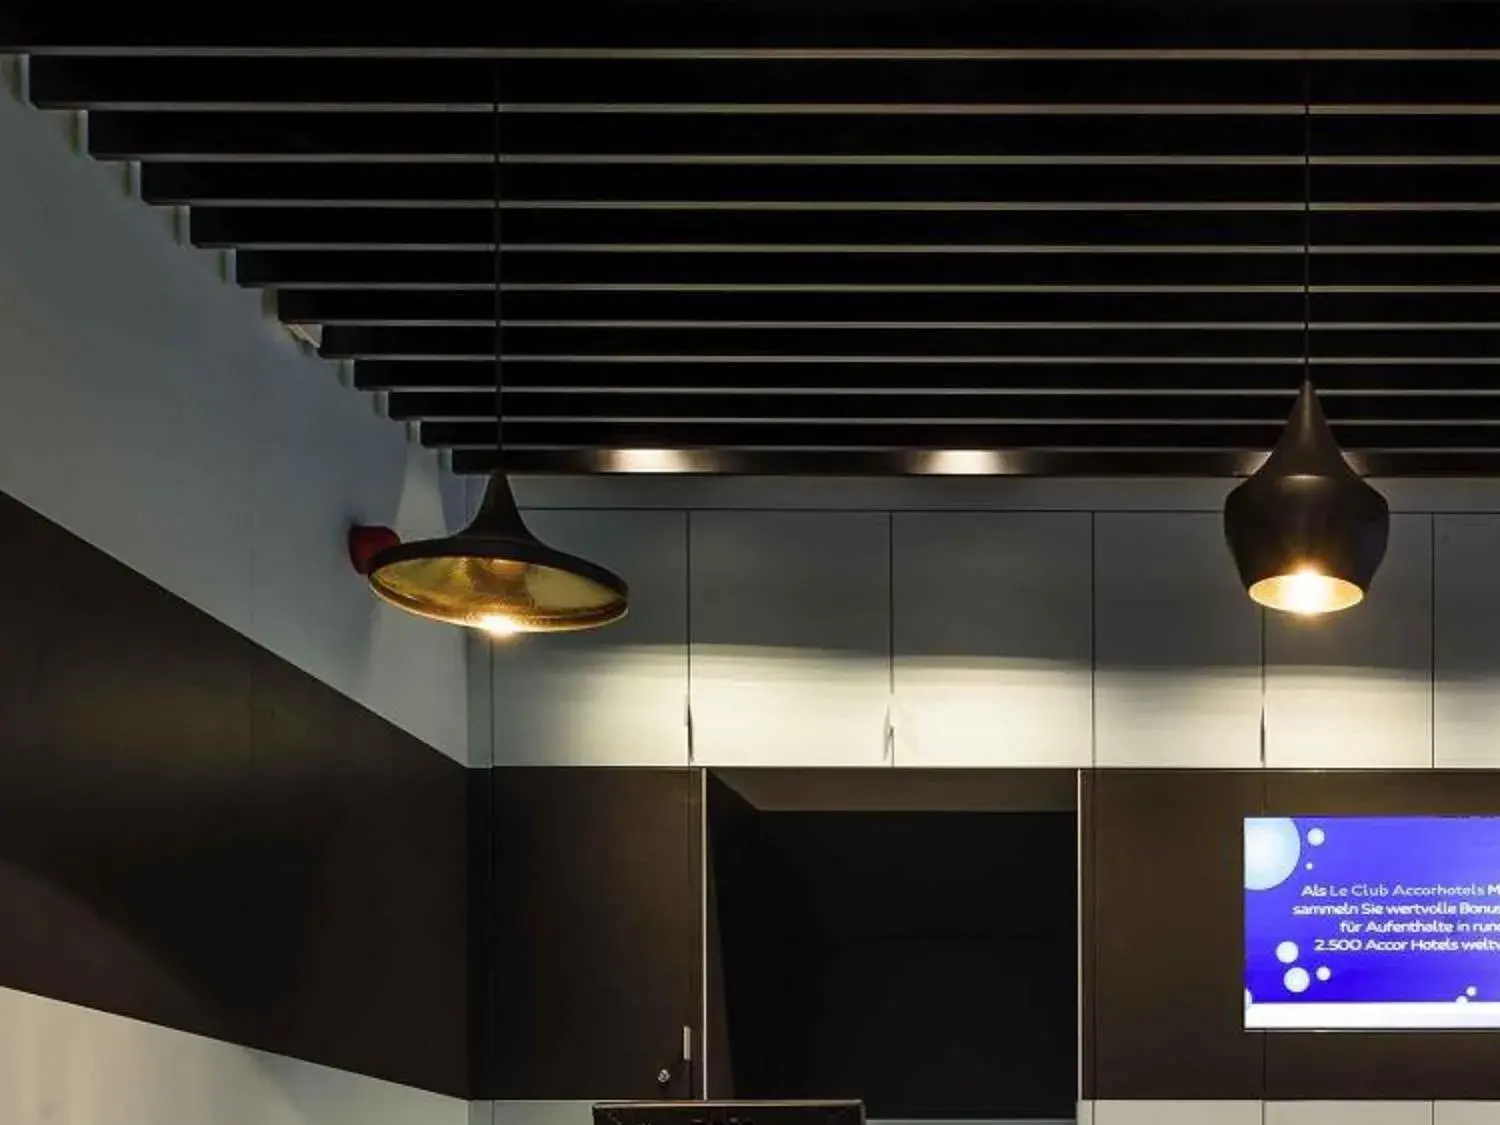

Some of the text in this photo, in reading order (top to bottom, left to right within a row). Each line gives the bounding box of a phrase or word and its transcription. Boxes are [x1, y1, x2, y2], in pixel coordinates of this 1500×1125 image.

[1301, 885, 1326, 896] Als
[1330, 885, 1347, 896] Le
[1352, 884, 1388, 896] Club
[1393, 884, 1484, 896] Accorhotels
[1292, 902, 1358, 915] sammeln
[1362, 902, 1383, 915] Sie
[1386, 902, 1456, 915] wertvolle
[1340, 920, 1362, 933] für
[1367, 920, 1453, 933] Aufenthalte
[1457, 920, 1469, 933] in
[1314, 939, 1362, 951] 2.500
[1366, 939, 1407, 951] Accor
[1411, 938, 1458, 951] Hotels
